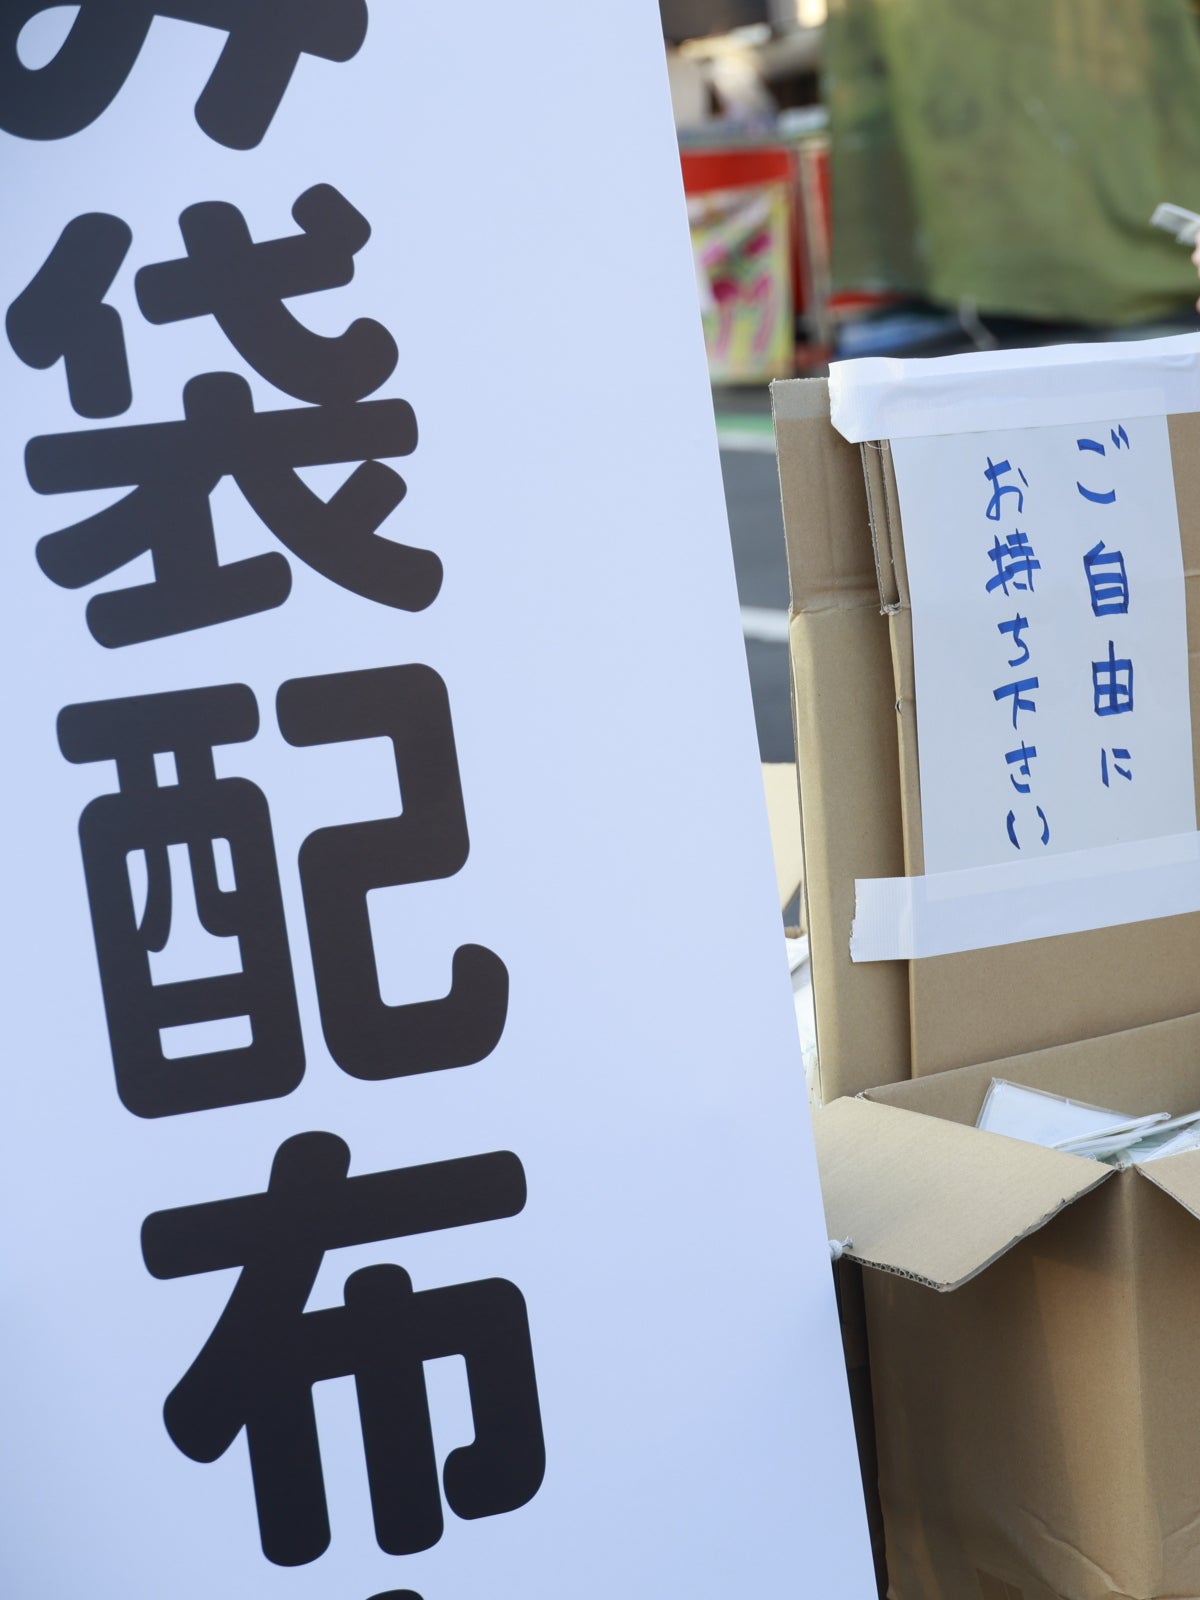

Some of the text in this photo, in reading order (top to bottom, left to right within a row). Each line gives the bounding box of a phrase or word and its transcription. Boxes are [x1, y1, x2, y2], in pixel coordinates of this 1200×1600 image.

[0, 0, 546, 1600] 袋配布
[984, 456, 1050, 850] お持ち下さい
[1077, 424, 1134, 788] ご自由に
